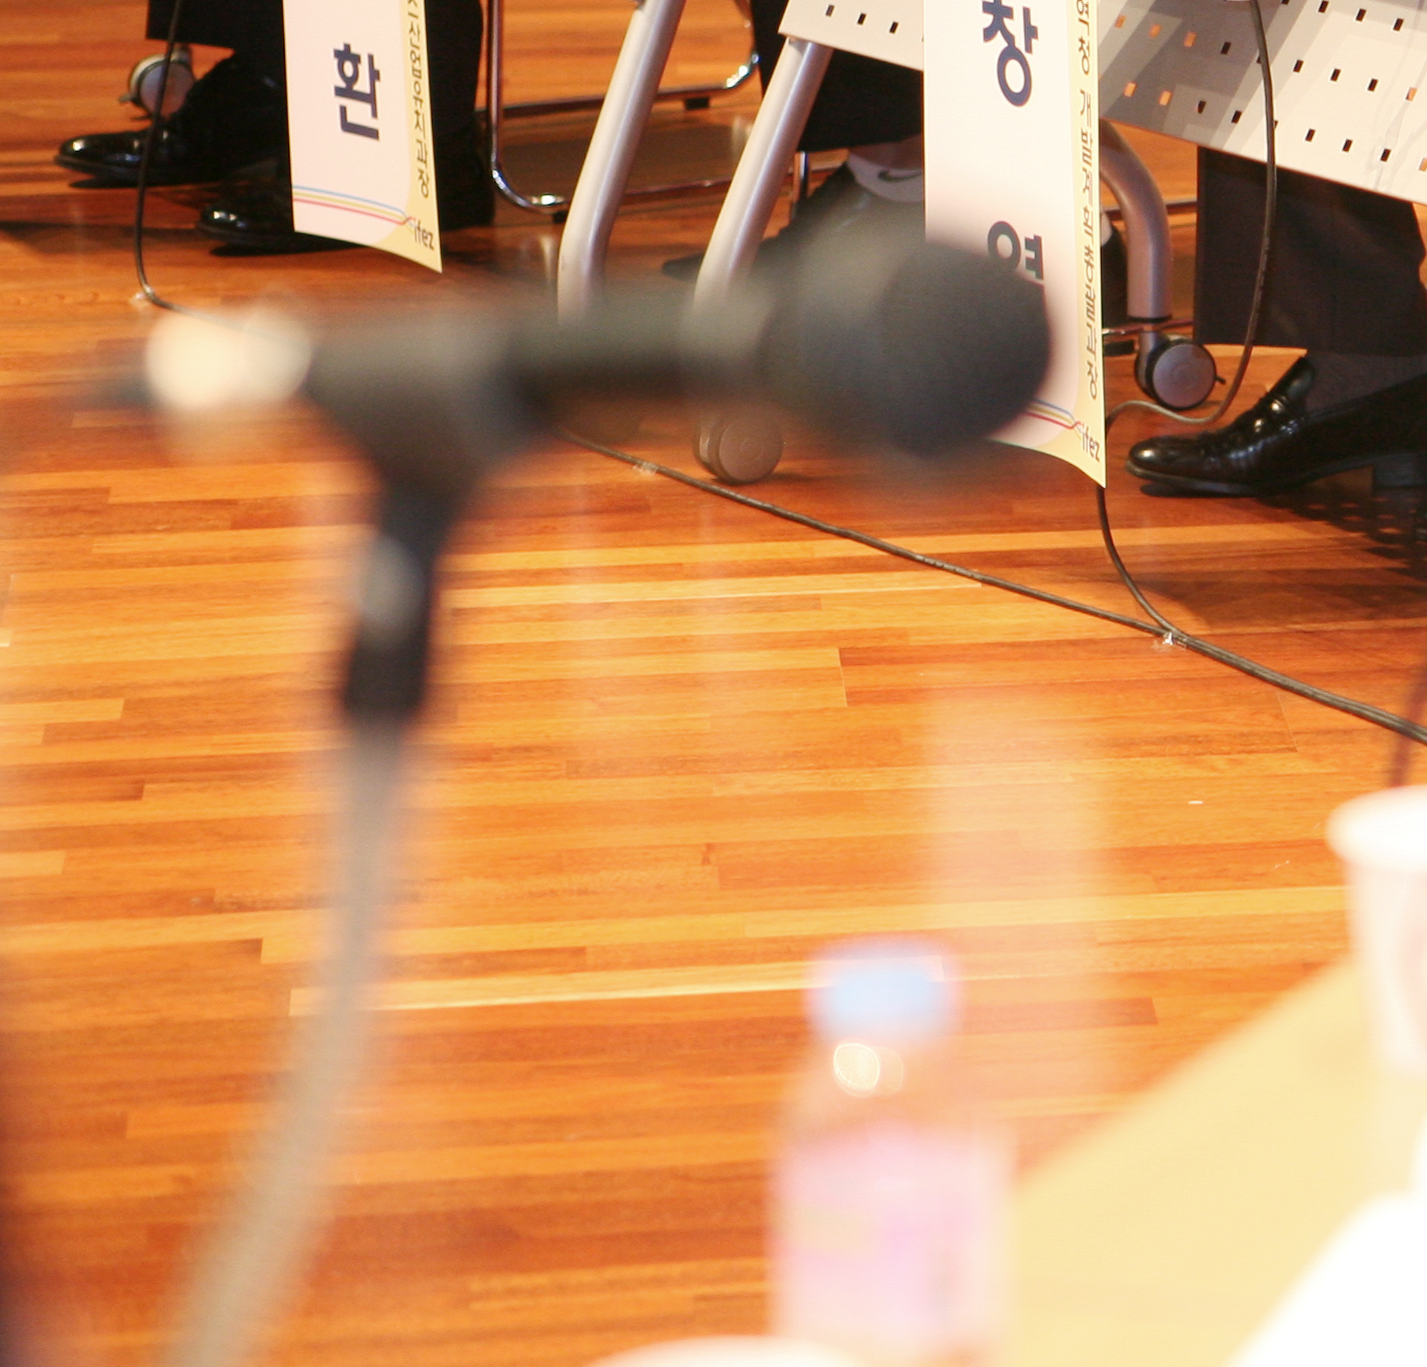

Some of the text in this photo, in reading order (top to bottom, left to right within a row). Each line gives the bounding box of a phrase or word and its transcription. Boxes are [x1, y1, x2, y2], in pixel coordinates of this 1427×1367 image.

[413, 220, 436, 252] ifez
[1078, 88, 1099, 401] 개발계획총괄과장
[1081, 426, 1101, 463] ifez
